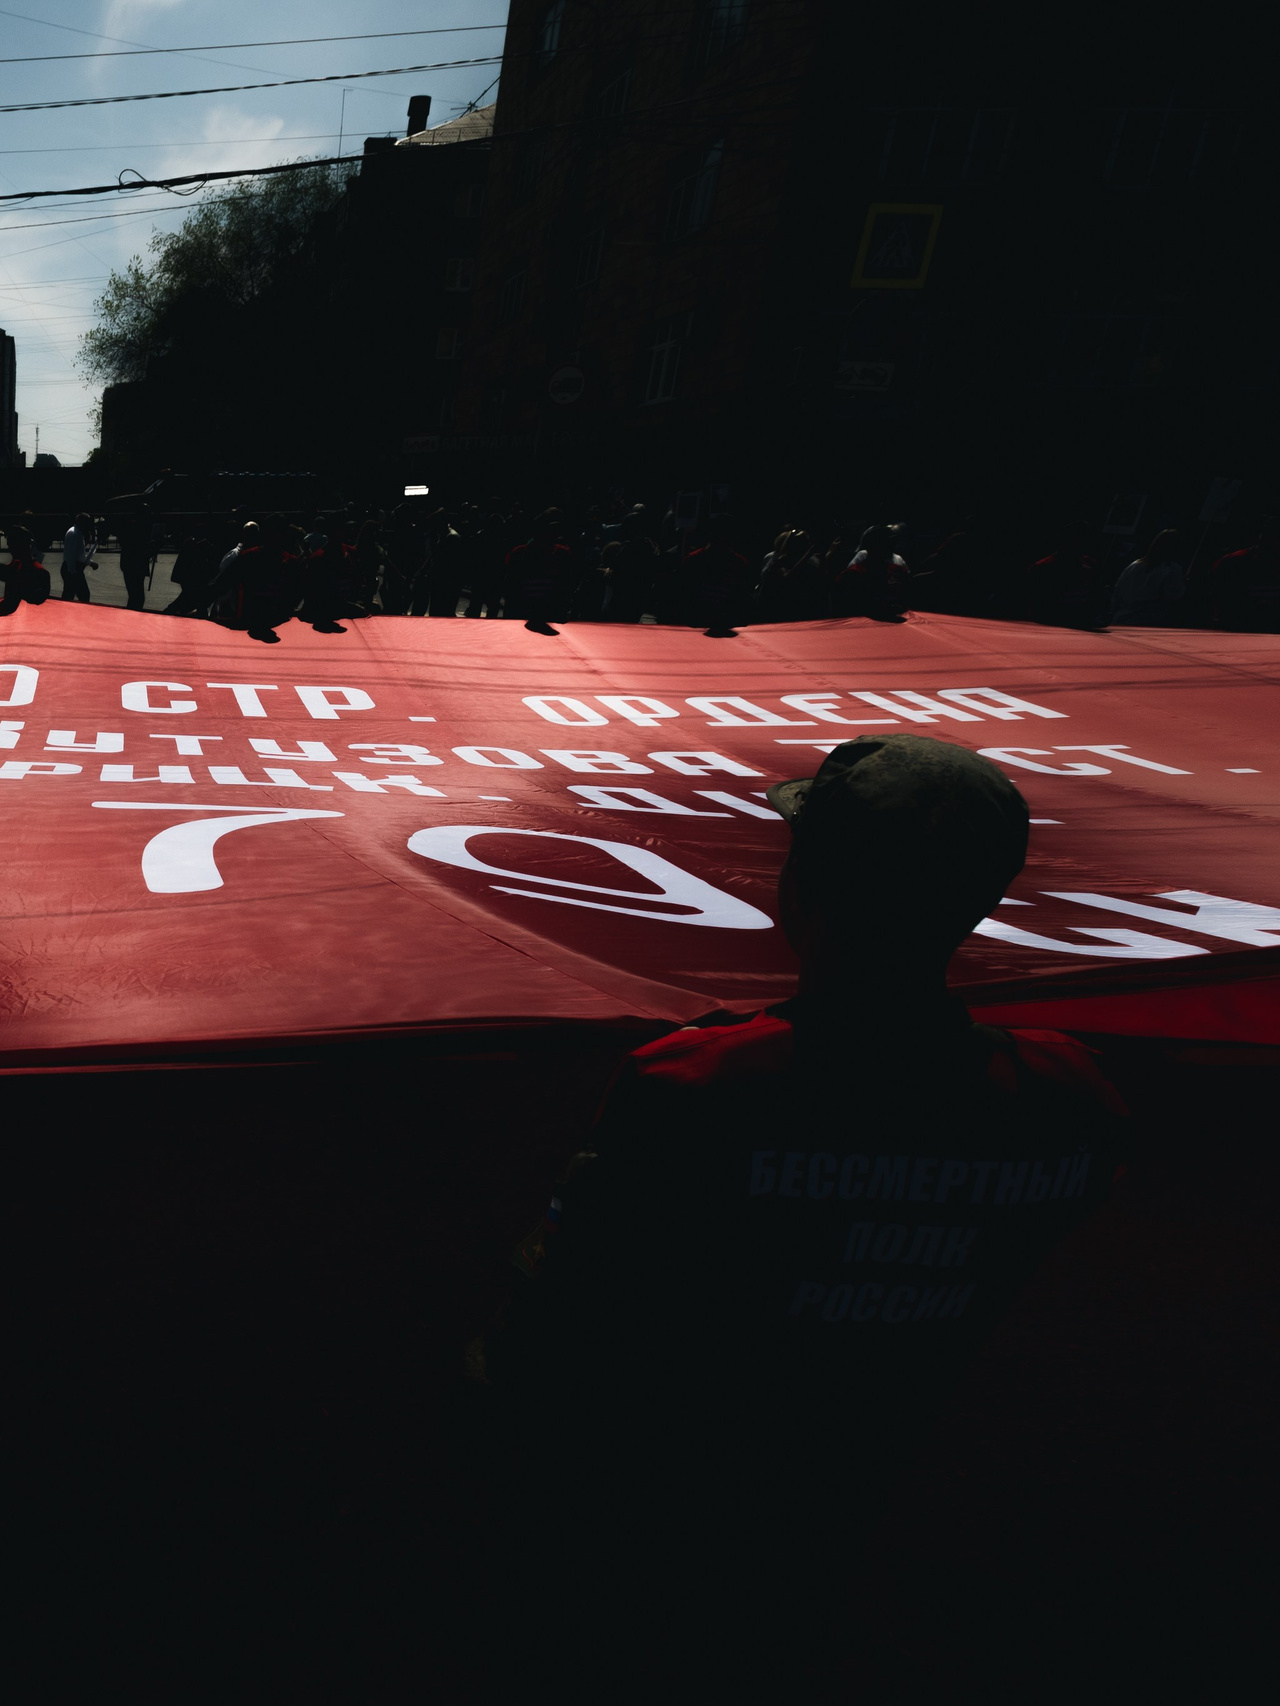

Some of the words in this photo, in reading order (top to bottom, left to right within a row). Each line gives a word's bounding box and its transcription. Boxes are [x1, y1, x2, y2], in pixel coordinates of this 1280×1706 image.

[521, 687, 1070, 728] ОРДЕНА
[91, 801, 775, 930] 79
[748, 1143, 1092, 1205] БЕССМЕРТНЫЙ
[841, 1220, 979, 1268] ПОЛК
[787, 1280, 978, 1324] РОССИИ
